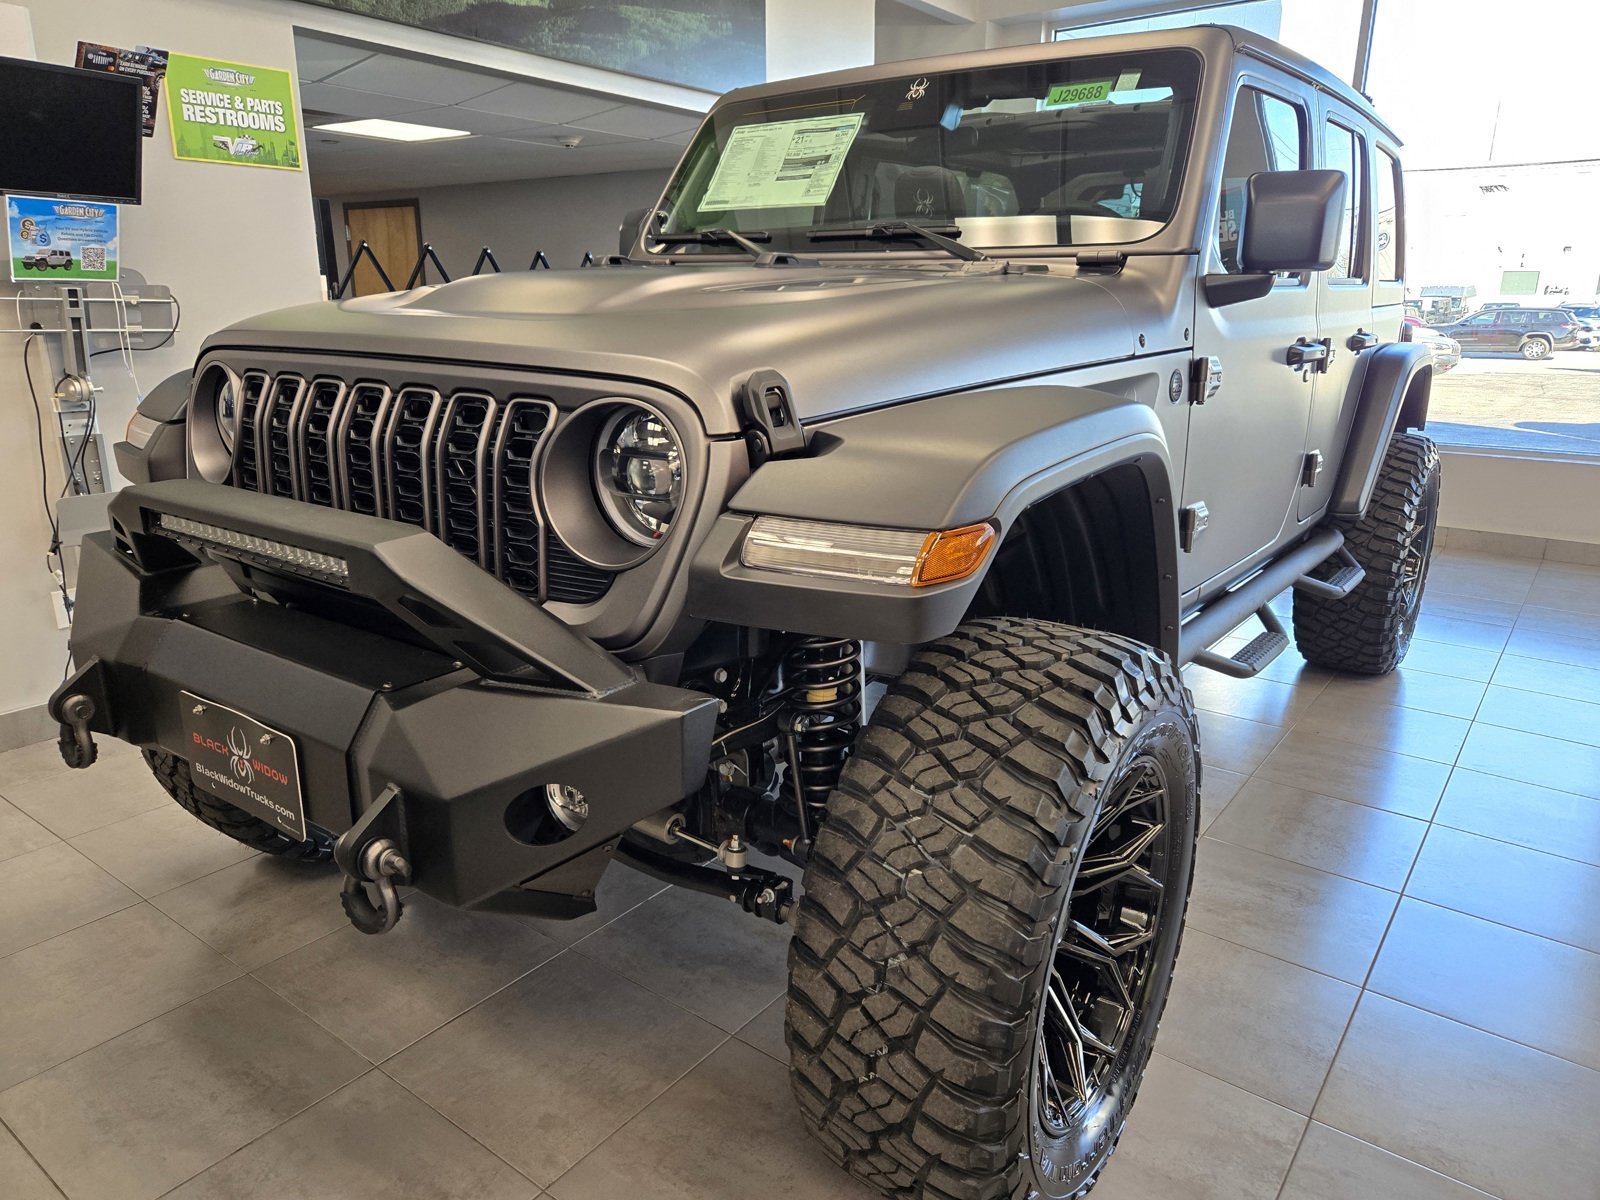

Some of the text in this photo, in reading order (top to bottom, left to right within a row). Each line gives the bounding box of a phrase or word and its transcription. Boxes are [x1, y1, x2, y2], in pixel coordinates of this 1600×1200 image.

[210, 68, 250, 85] GARDEN CITY
[180, 88, 283, 115] SERVICE & PARTS
[1053, 85, 1103, 103] J29688
[182, 103, 286, 133] RESTROOMS
[794, 136, 805, 144] 21
[59, 204, 99, 218] GARDEN CITY
[192, 731, 288, 786] BLACK WIDOW
[195, 762, 296, 821] BlackWidowTrucks.com
